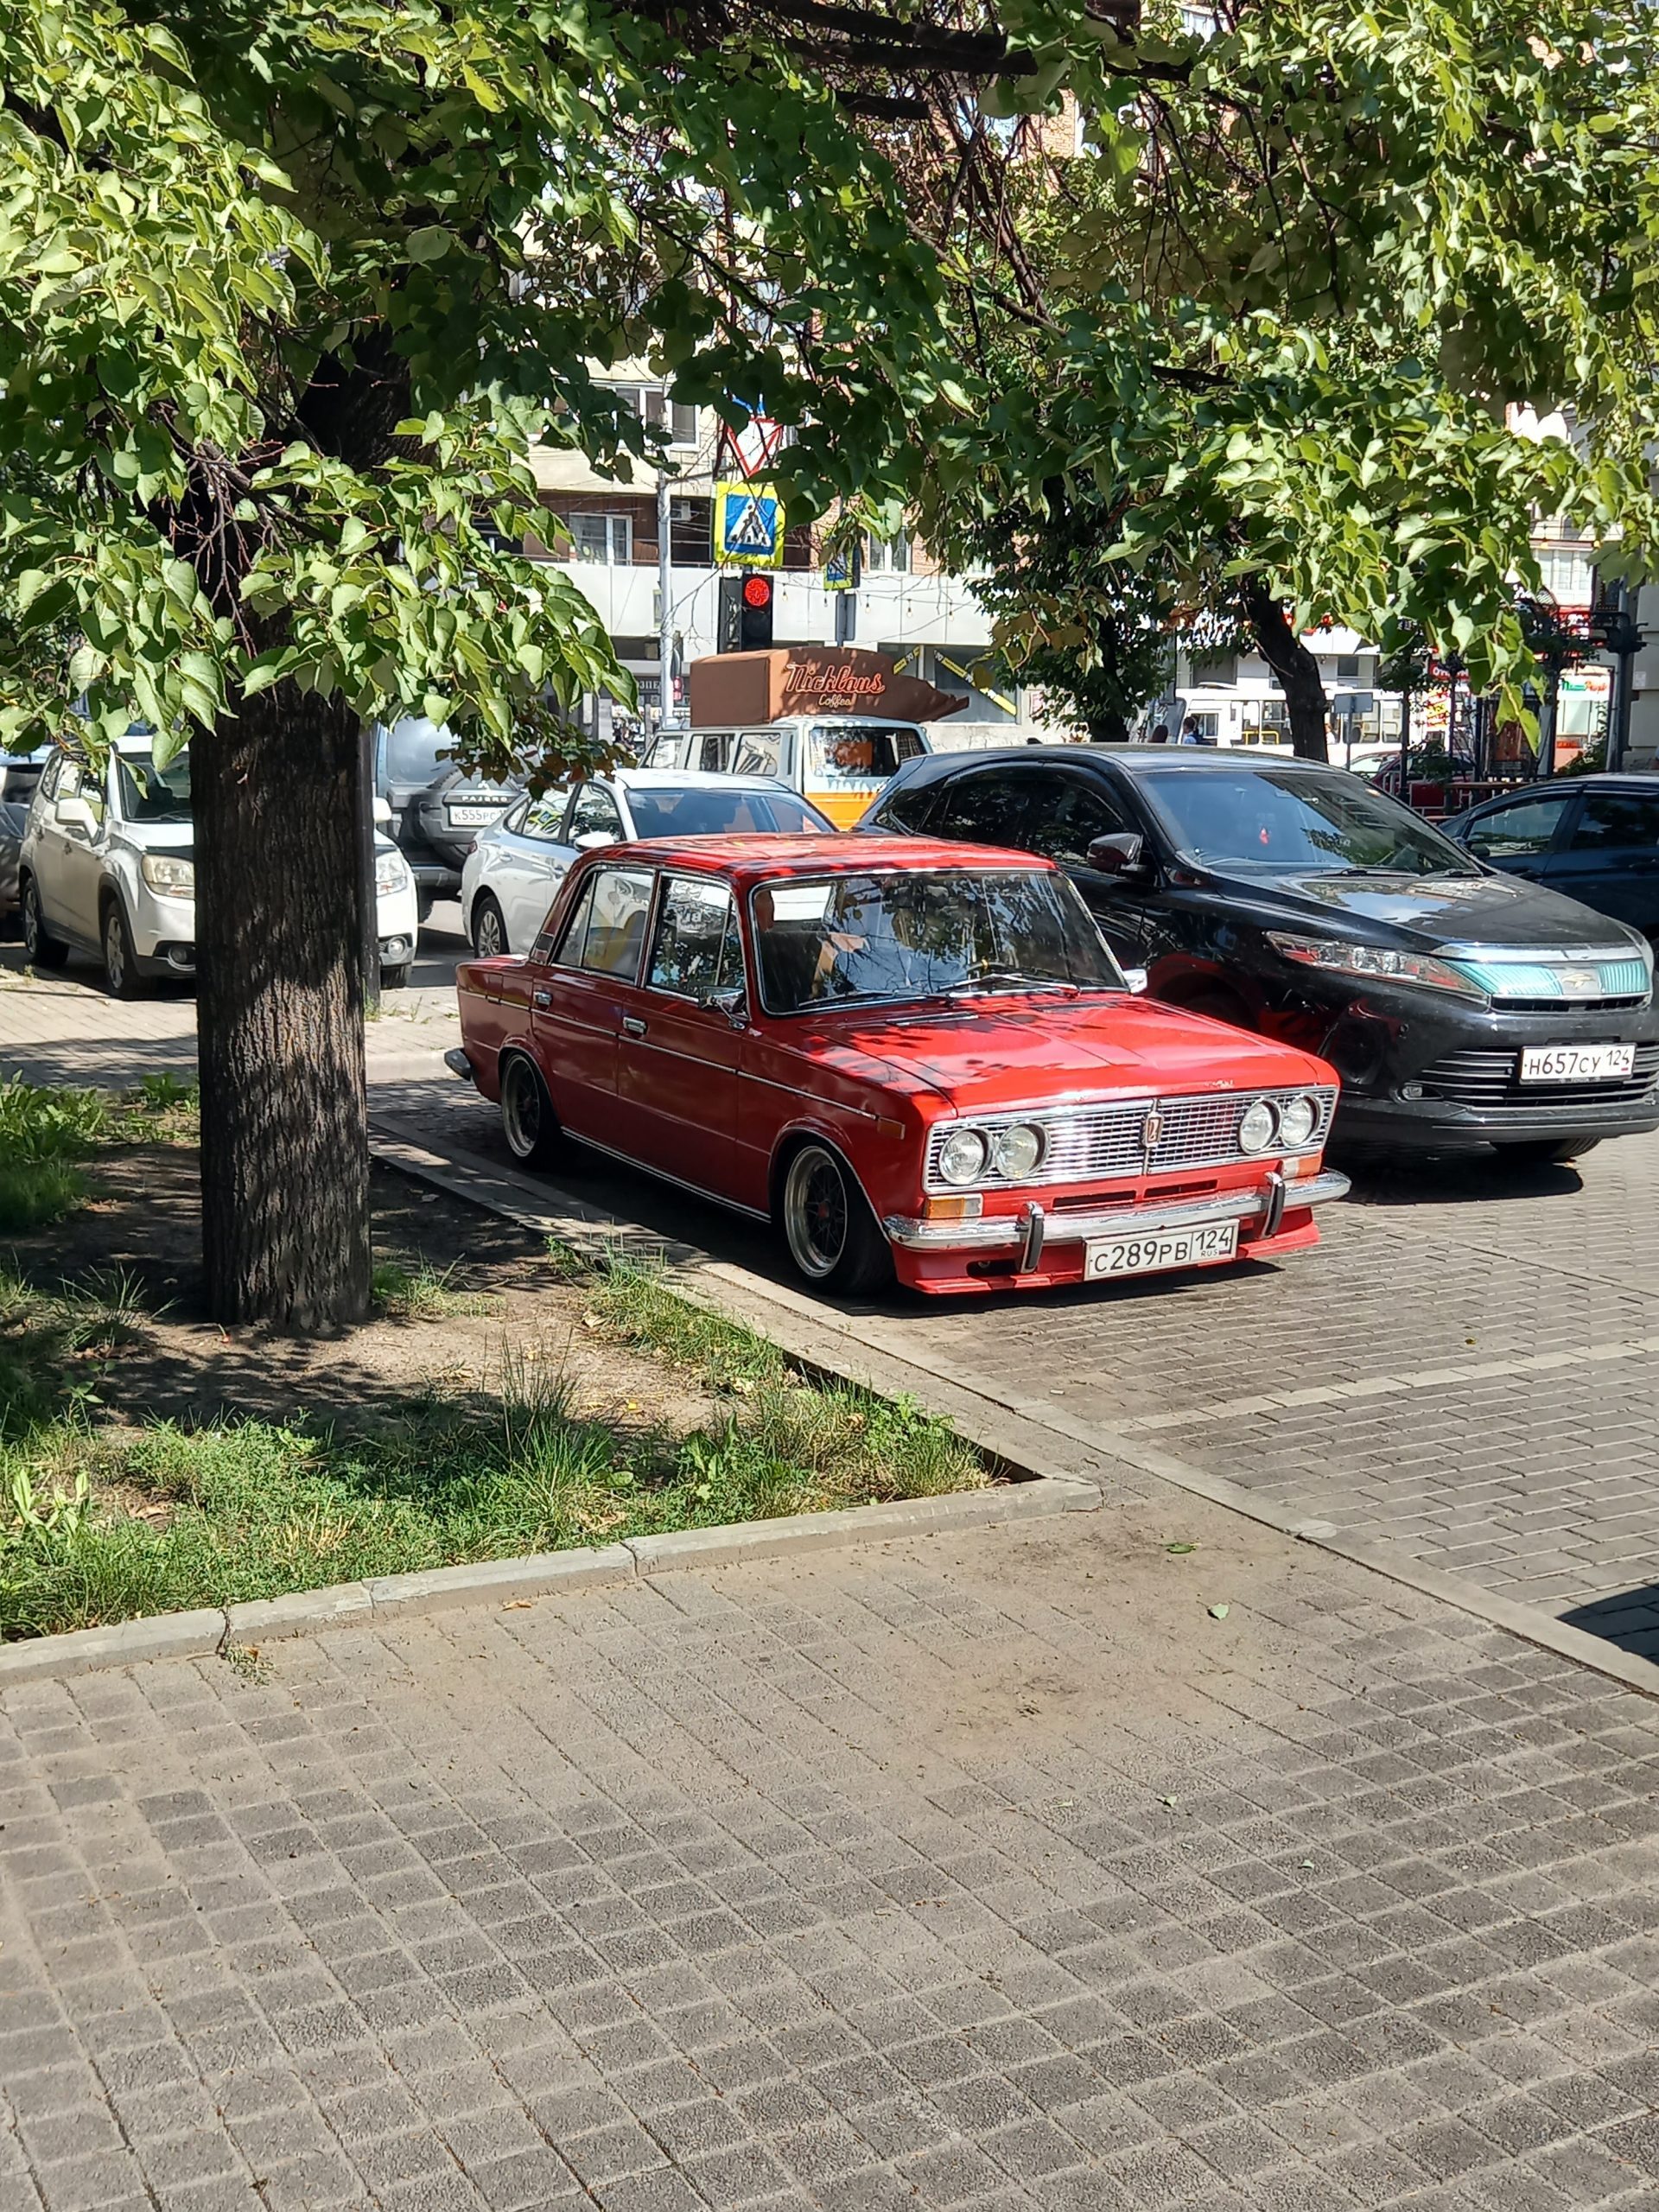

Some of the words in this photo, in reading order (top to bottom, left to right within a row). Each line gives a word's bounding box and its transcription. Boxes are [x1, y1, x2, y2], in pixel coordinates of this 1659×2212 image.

[818, 694, 852, 708] Coffee
[1607, 1049, 1630, 1065] 124
[1195, 1226, 1231, 1250] 124
